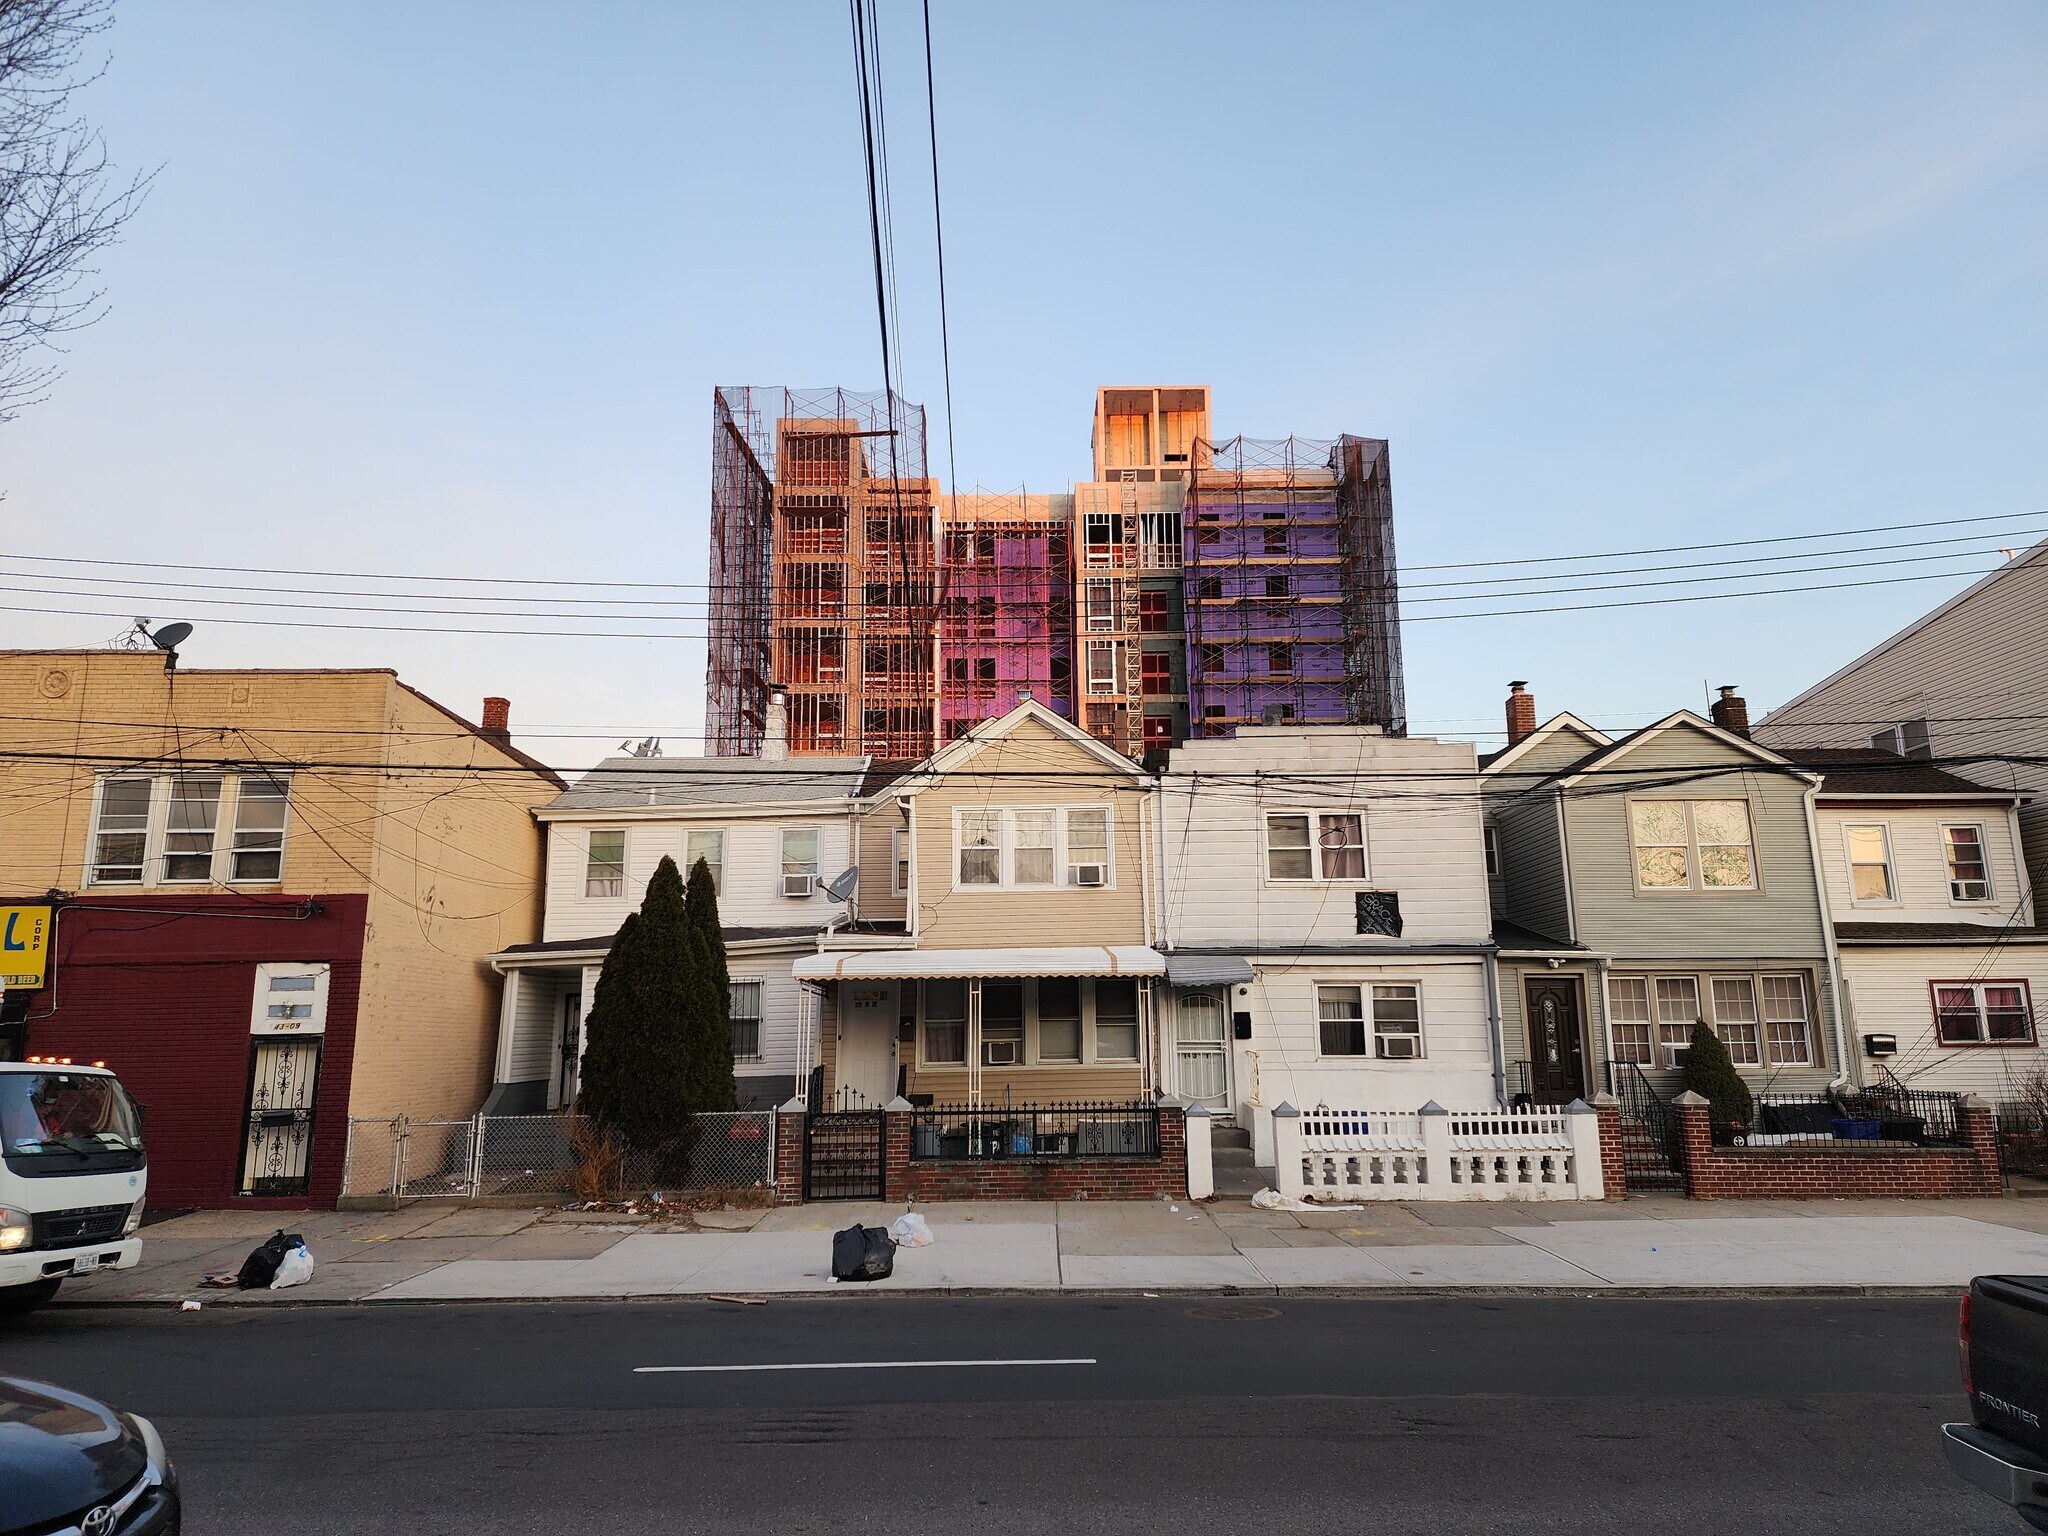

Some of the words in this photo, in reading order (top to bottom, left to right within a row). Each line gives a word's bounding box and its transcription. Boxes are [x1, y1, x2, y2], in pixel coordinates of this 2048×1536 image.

[1364, 894, 1396, 926] GRACE
[32, 919, 42, 950] CORP
[4, 976, 16, 984] OLD
[17, 975, 36, 984] BEER
[273, 1022, 301, 1031] 43-09
[1979, 1390, 2041, 1429] FRONTIER
